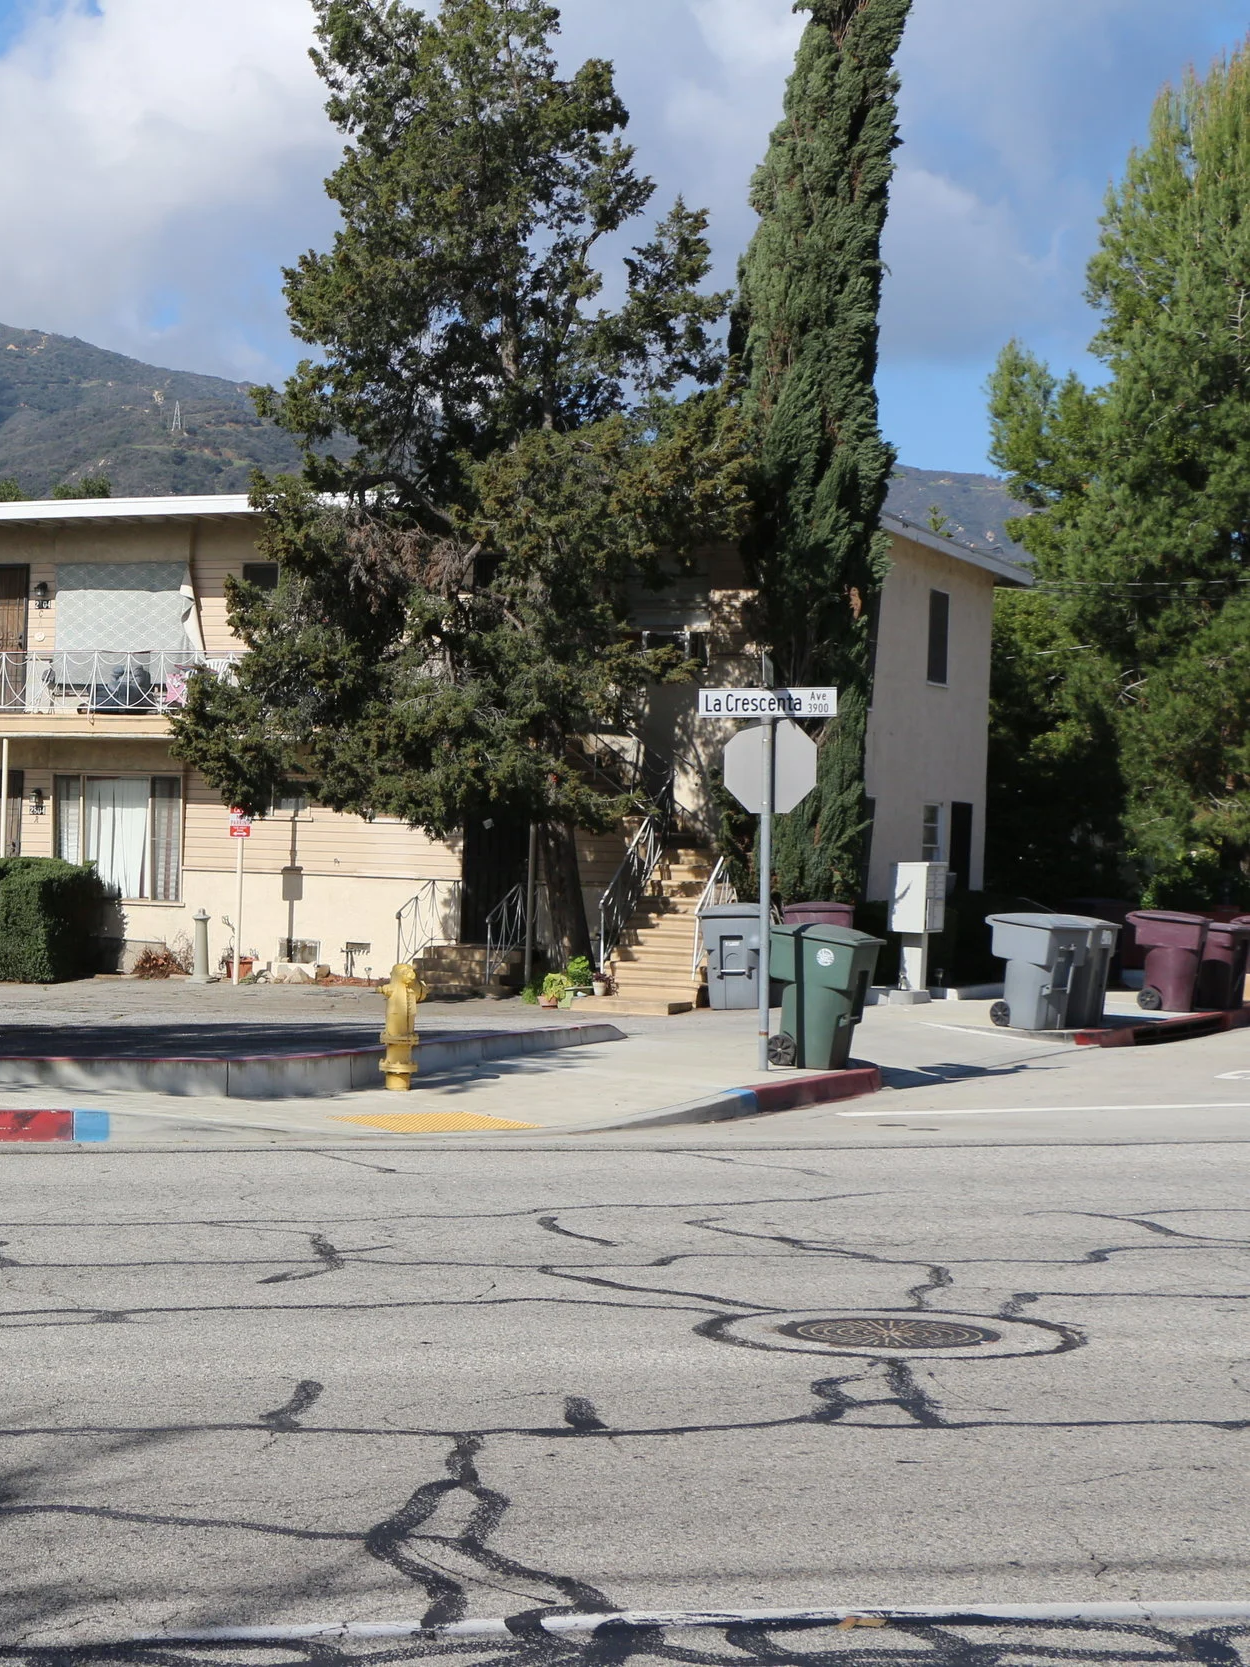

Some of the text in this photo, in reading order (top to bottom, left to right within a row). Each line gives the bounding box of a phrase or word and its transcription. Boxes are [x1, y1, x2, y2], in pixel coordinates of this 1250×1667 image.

[810, 691, 827, 700] Ave
[705, 694, 802, 712] La Crescenta
[808, 703, 829, 713] 3900
